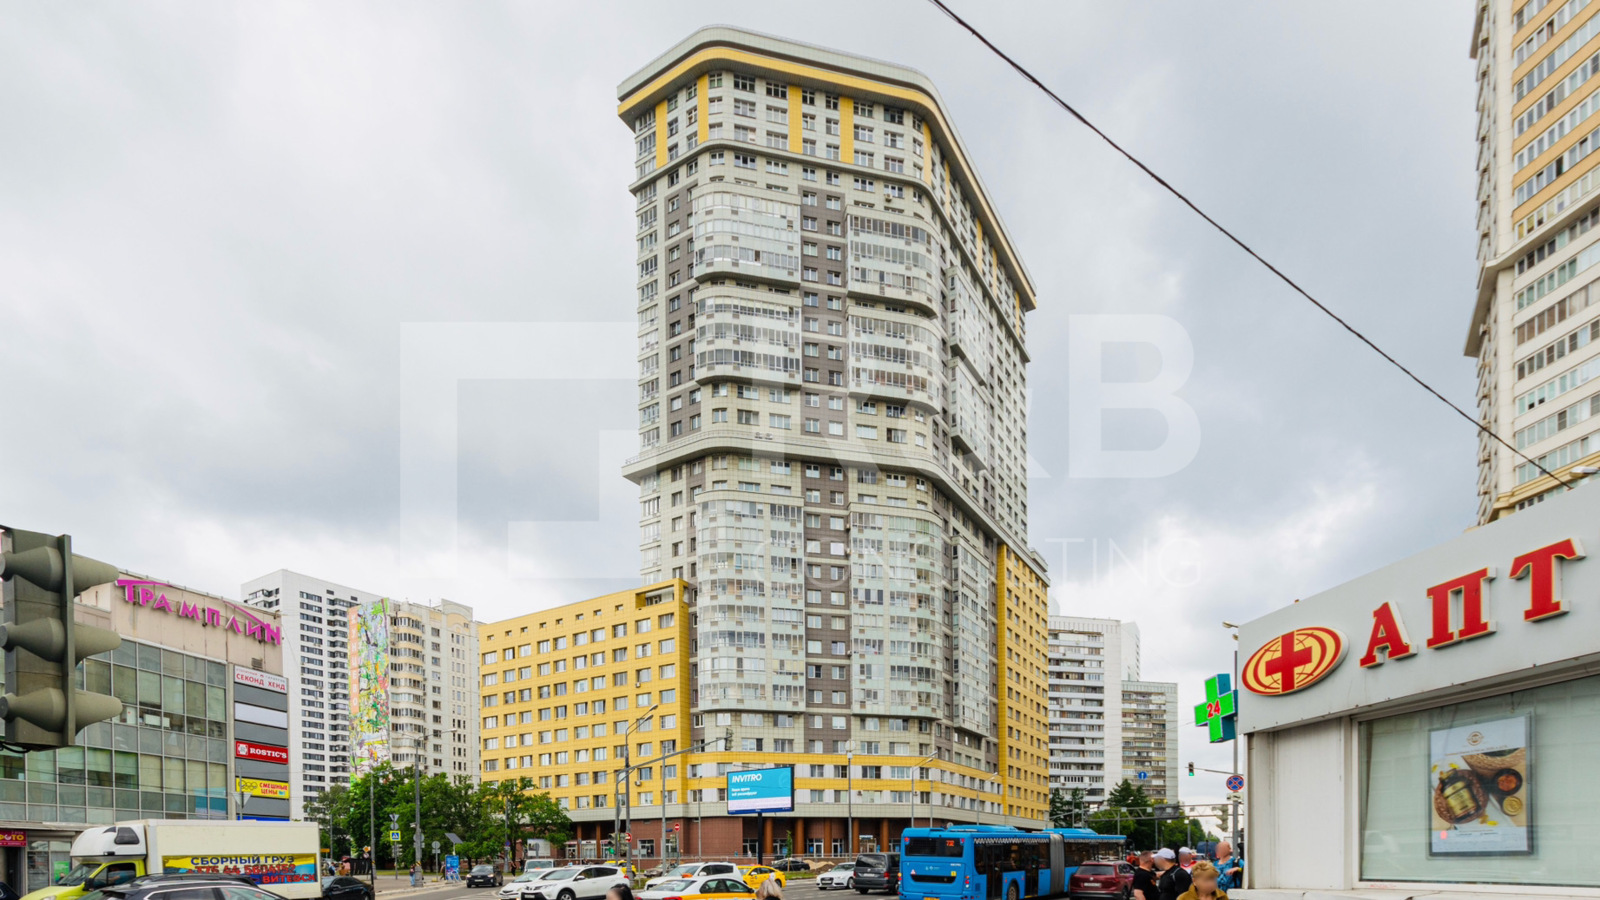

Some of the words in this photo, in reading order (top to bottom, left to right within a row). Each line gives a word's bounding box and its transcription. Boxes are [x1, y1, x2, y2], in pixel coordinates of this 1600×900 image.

[1360, 538, 1585, 669] АПТ
[236, 673, 265, 686] СЕКОНД
[268, 681, 286, 691] ХЕНД
[1207, 700, 1221, 718] 24
[250, 748, 287, 759] ROSTIC'S
[732, 774, 762, 783] INVITRO
[259, 782, 288, 791] СМЕШНЫЕ
[190, 855, 261, 865] СБОРНЫЙ
[264, 855, 295, 865] ГРУЗ
[262, 874, 315, 884] ВИТЕБСК
